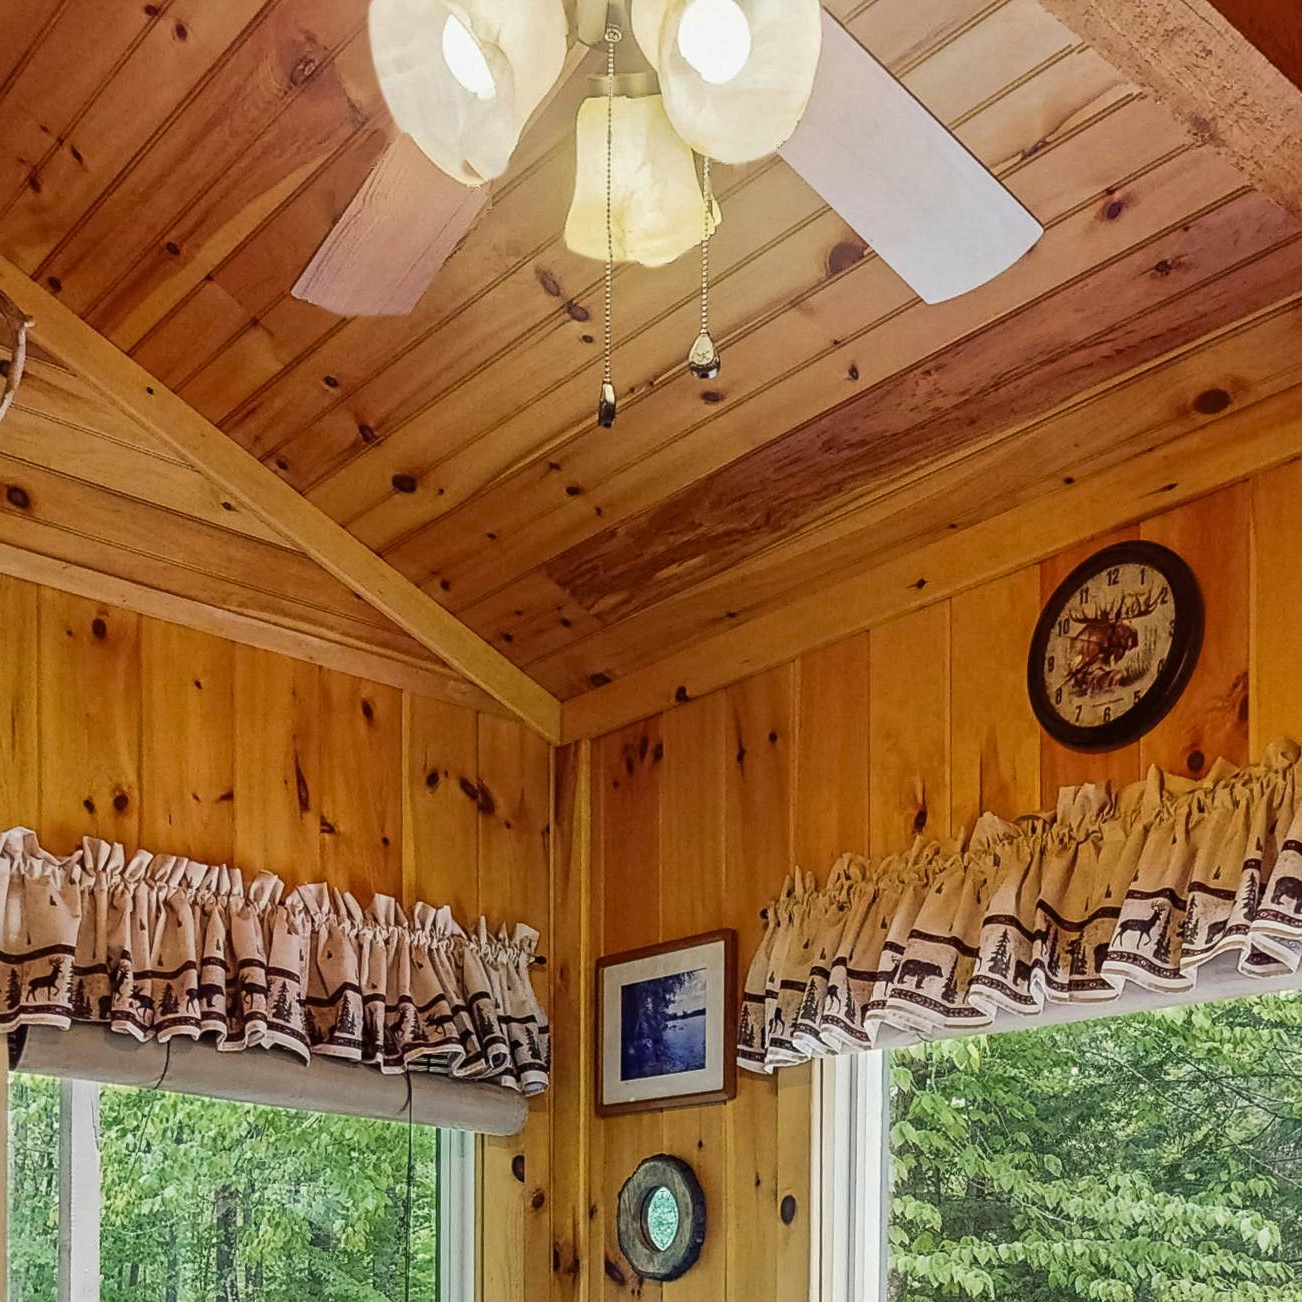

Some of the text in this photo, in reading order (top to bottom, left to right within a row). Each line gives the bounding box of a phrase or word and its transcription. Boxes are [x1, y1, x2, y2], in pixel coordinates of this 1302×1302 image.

[1107, 568, 1120, 586] 12
[1140, 568, 1145, 585] 1
[1079, 586, 1089, 605] 11
[1160, 586, 1168, 604] 2
[1058, 618, 1069, 637] 10
